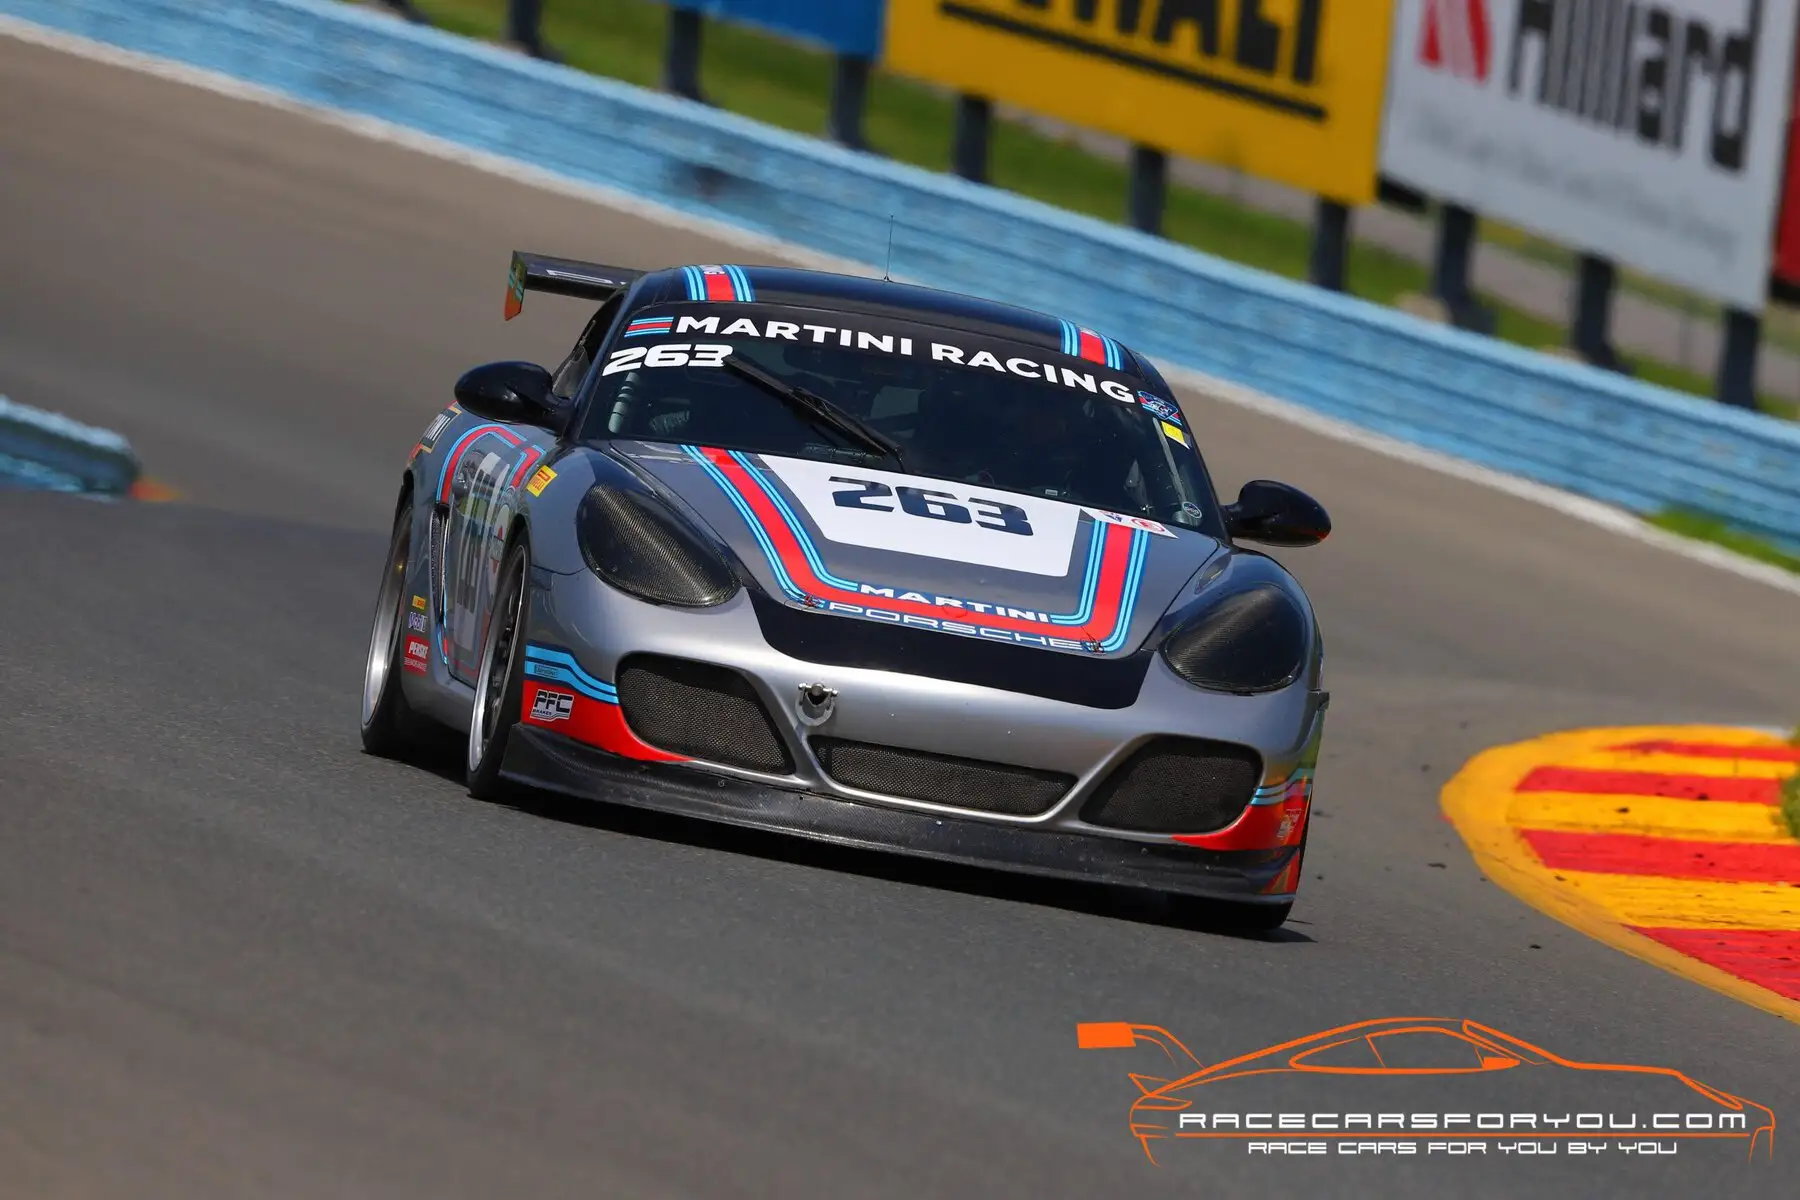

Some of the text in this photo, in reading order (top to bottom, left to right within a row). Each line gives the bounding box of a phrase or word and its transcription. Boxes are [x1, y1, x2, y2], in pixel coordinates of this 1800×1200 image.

[602, 344, 733, 376] 263
[676, 316, 1136, 404] MARTINI RACING
[828, 475, 1034, 536] 263
[860, 584, 1050, 623] MARTINI
[829, 602, 1083, 650] PORSCHE
[533, 690, 574, 713] PFC
